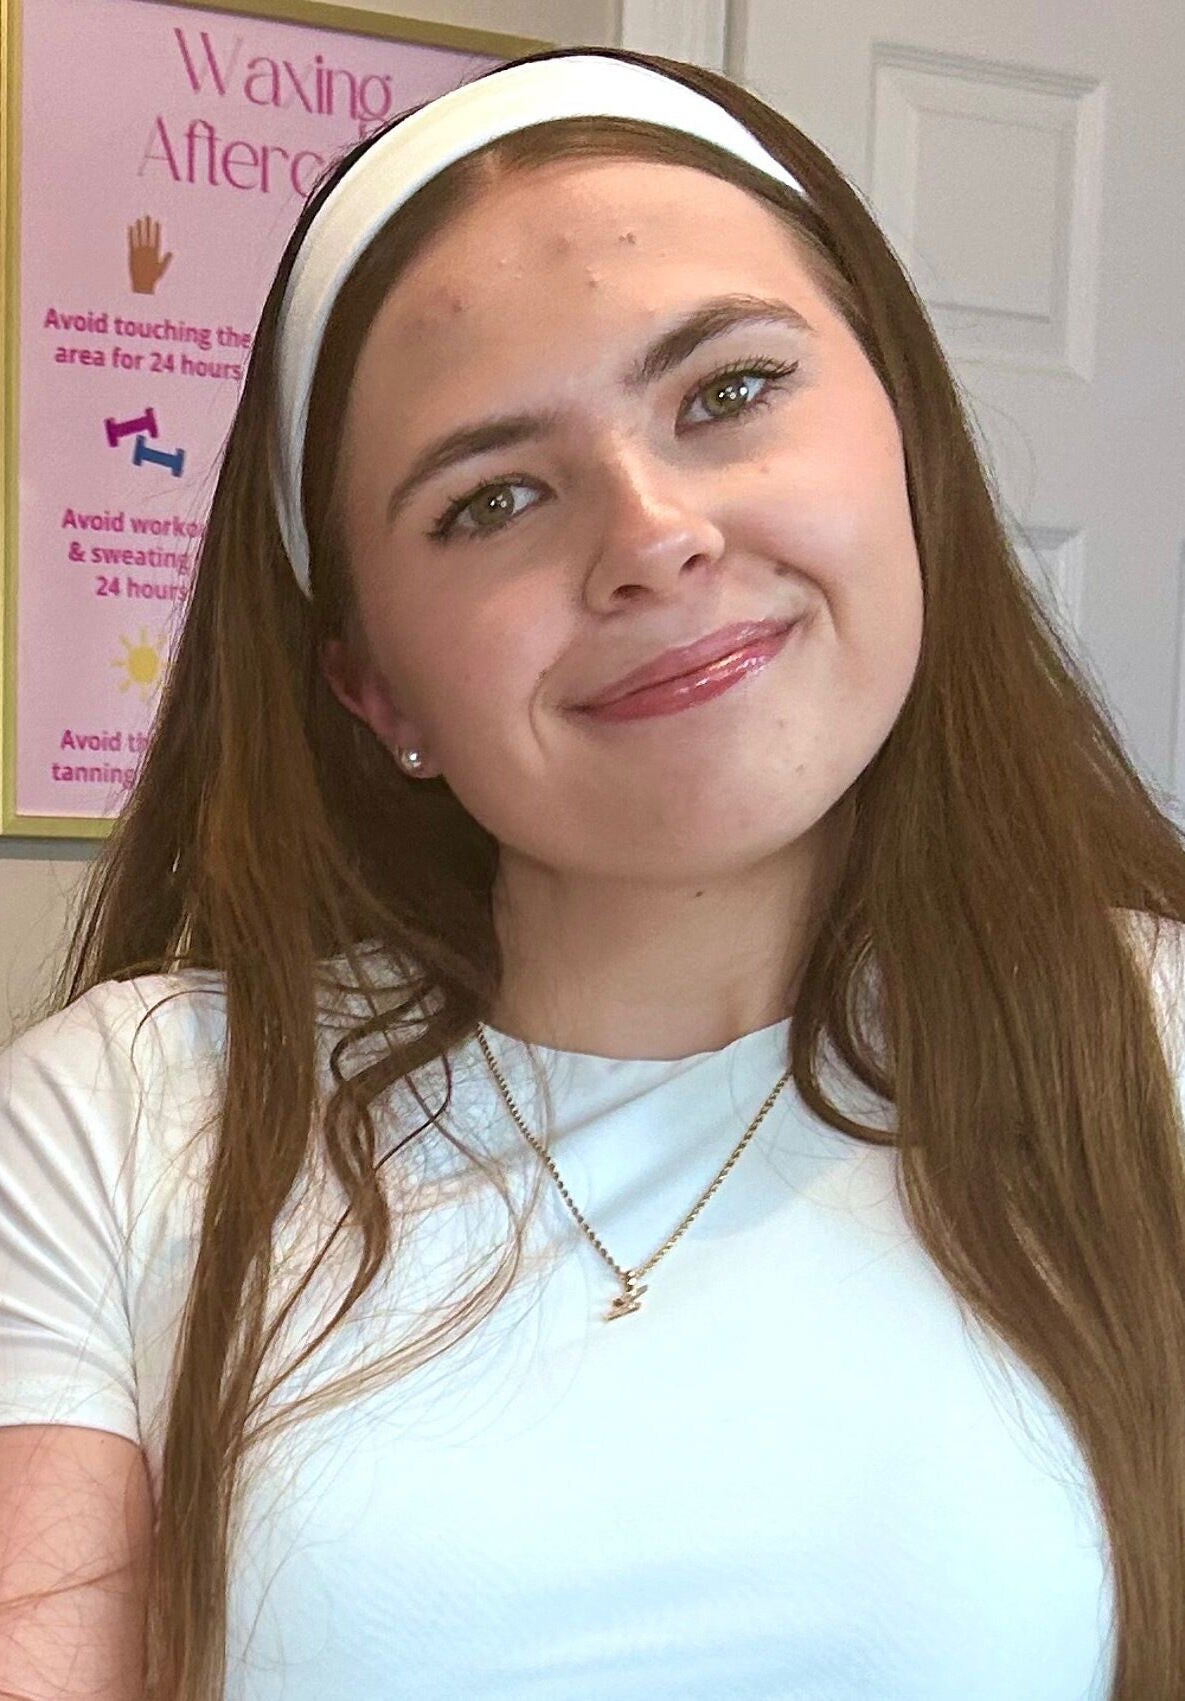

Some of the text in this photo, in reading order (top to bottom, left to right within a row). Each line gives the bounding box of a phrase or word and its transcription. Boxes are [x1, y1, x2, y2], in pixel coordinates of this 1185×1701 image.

[174, 27, 392, 139] Waxing
[44, 308, 251, 350] Avoid touching the
[55, 346, 242, 380] area for 24 hours
[62, 508, 124, 532] Avoid
[68, 541, 190, 576] & sweating
[96, 575, 188, 600] 24 hours
[61, 729, 121, 751] Avoid
[52, 762, 135, 790] tanning
